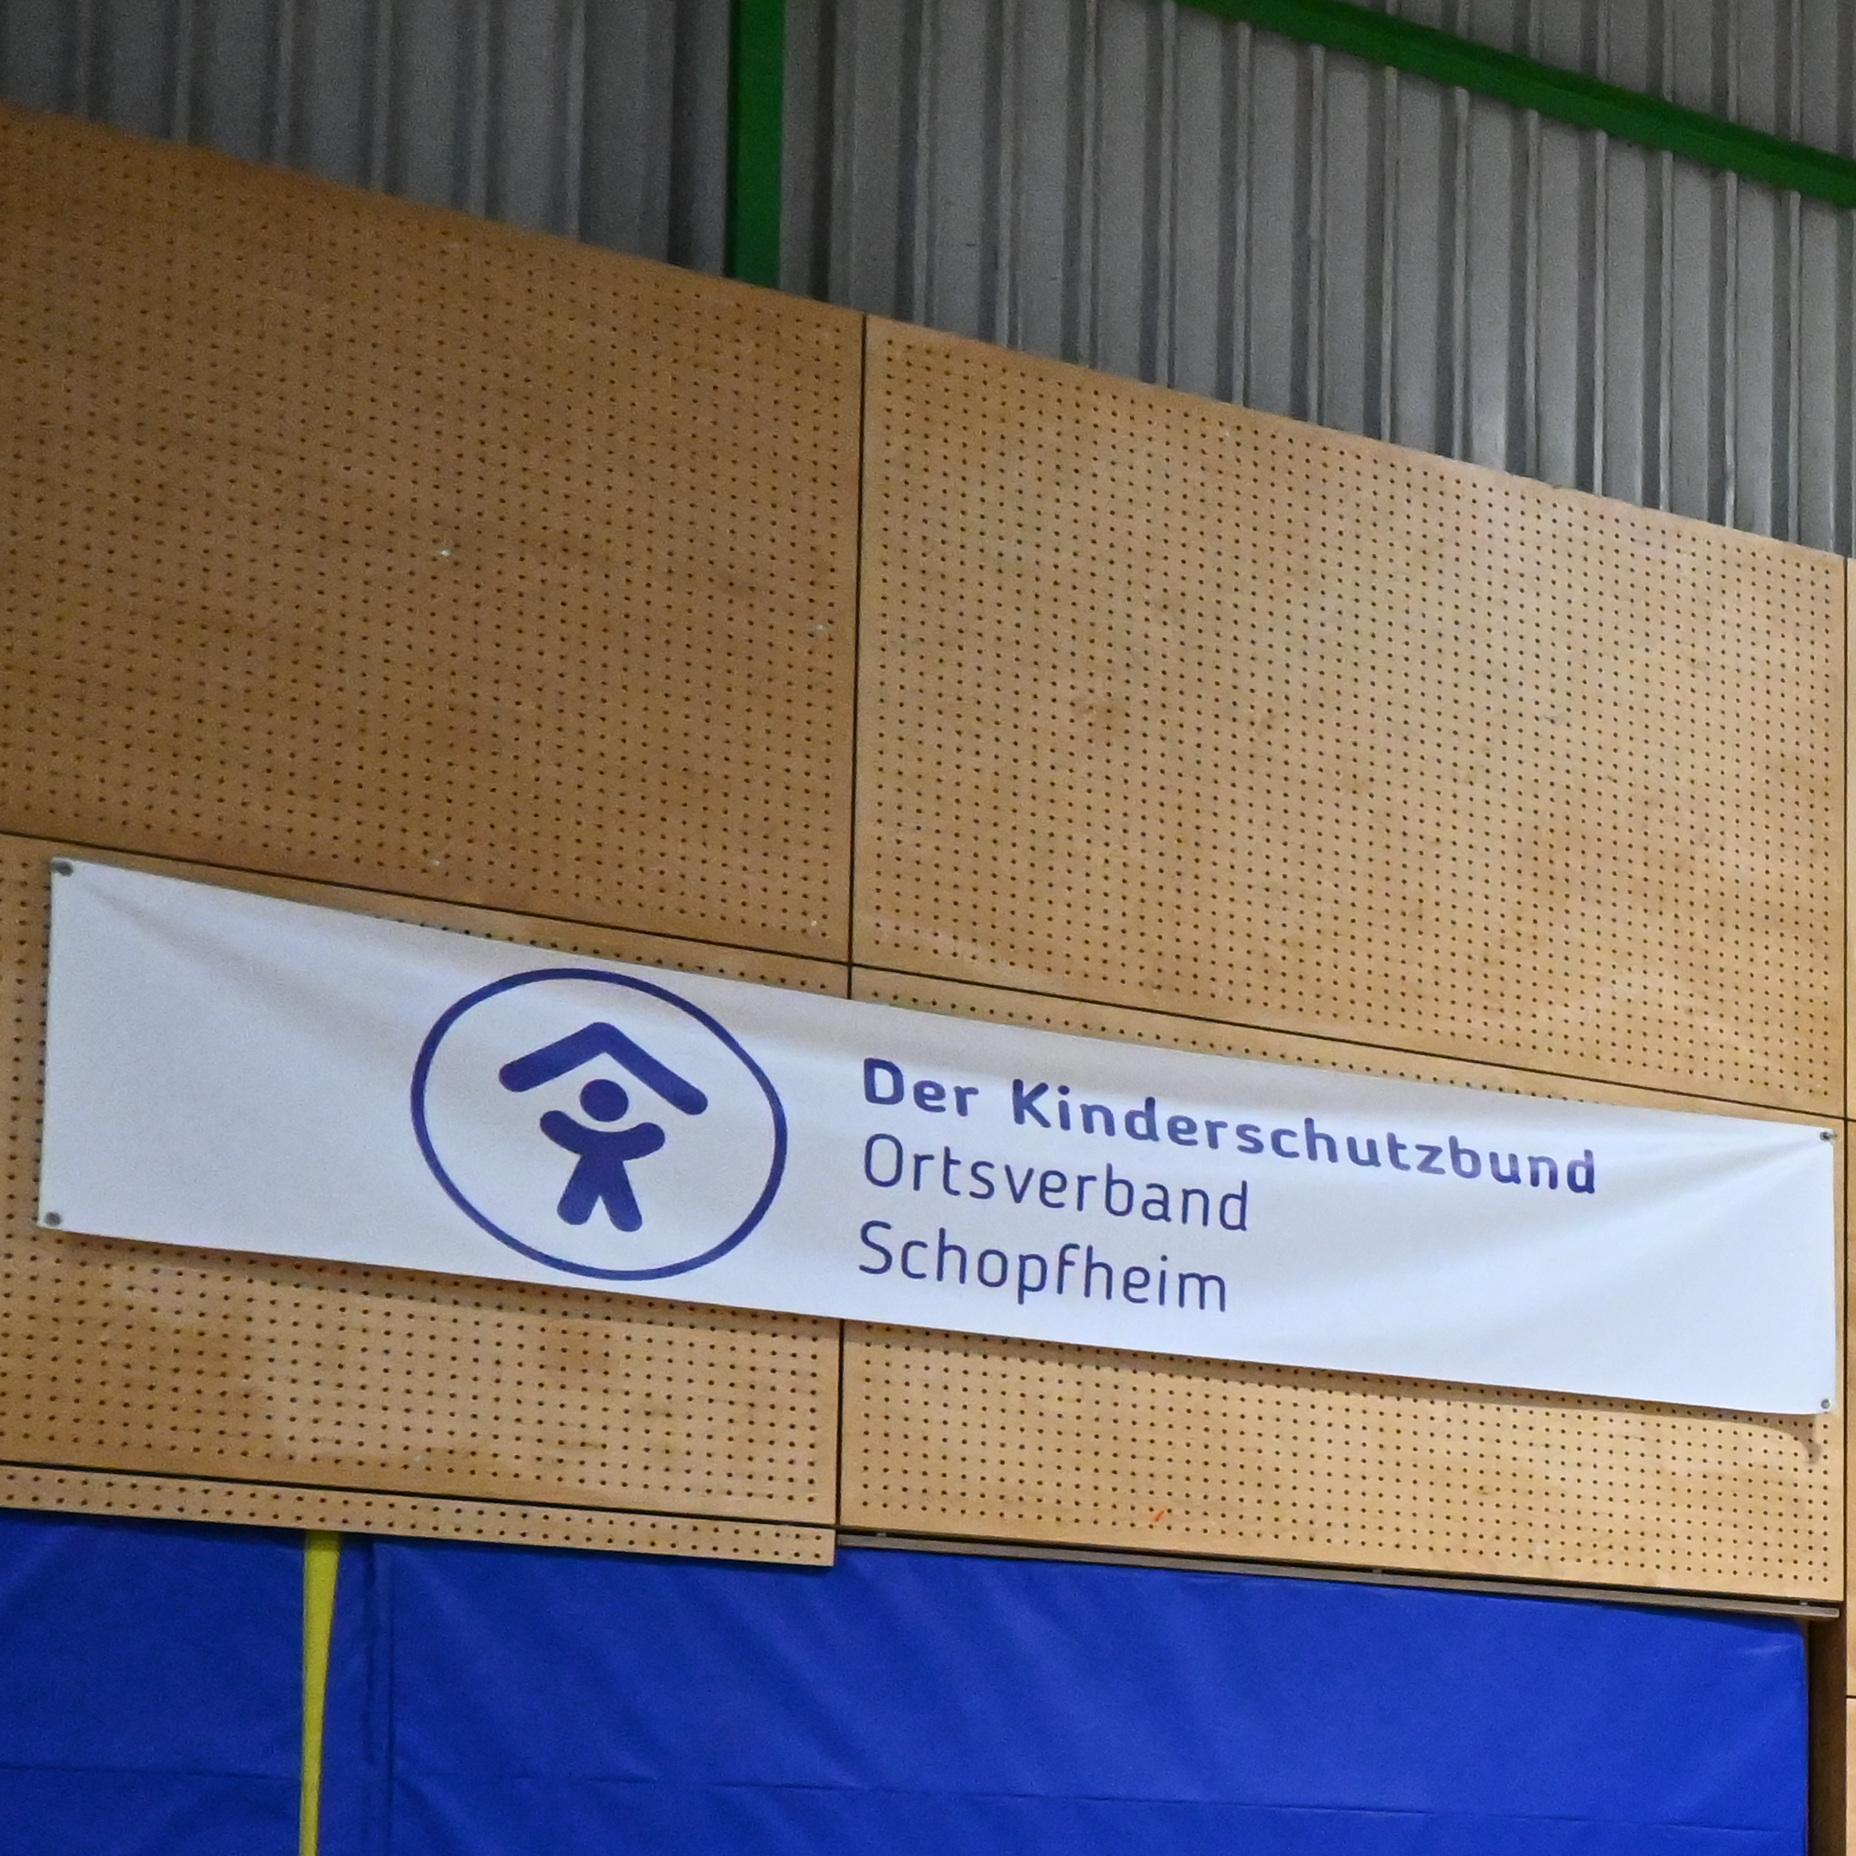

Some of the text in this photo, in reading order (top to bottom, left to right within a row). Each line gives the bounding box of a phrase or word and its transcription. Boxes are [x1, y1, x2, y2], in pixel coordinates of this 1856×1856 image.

[862, 1056, 1596, 1194] Der Kinderschutzbund
[863, 1132, 1248, 1232] Ortsverband
[858, 1219, 1227, 1312] Schopfheim
